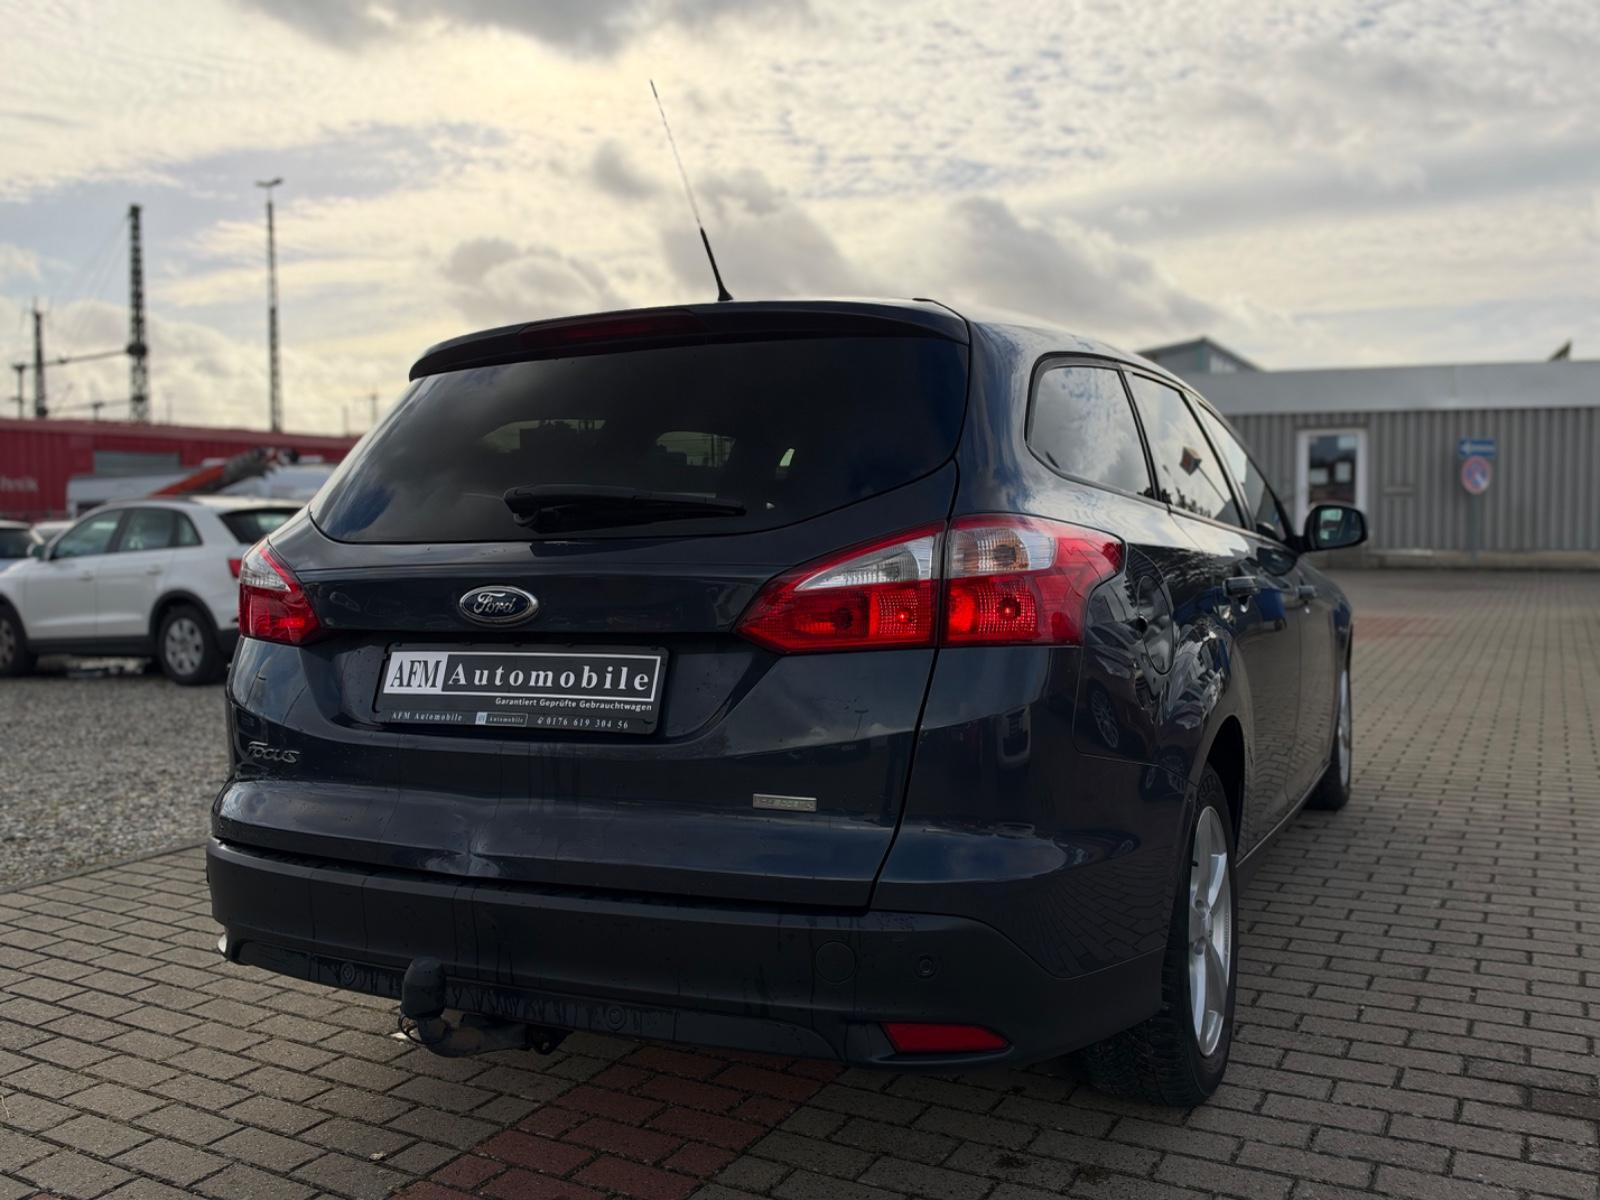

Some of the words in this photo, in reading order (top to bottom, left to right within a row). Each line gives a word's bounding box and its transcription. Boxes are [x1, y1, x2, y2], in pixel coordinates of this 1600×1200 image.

[473, 592, 516, 613] Ford
[390, 660, 442, 688] AFM
[449, 663, 649, 690] Automobile
[495, 697, 538, 707] Garantiert
[540, 698, 577, 709] Geprüfte
[579, 700, 653, 712] Gebrauchtwagen
[391, 711, 411, 720] AFM
[414, 712, 463, 721] Automobile
[546, 716, 568, 726] 0176
[573, 717, 591, 727] 619
[595, 719, 612, 728] 304
[617, 719, 629, 729] 56
